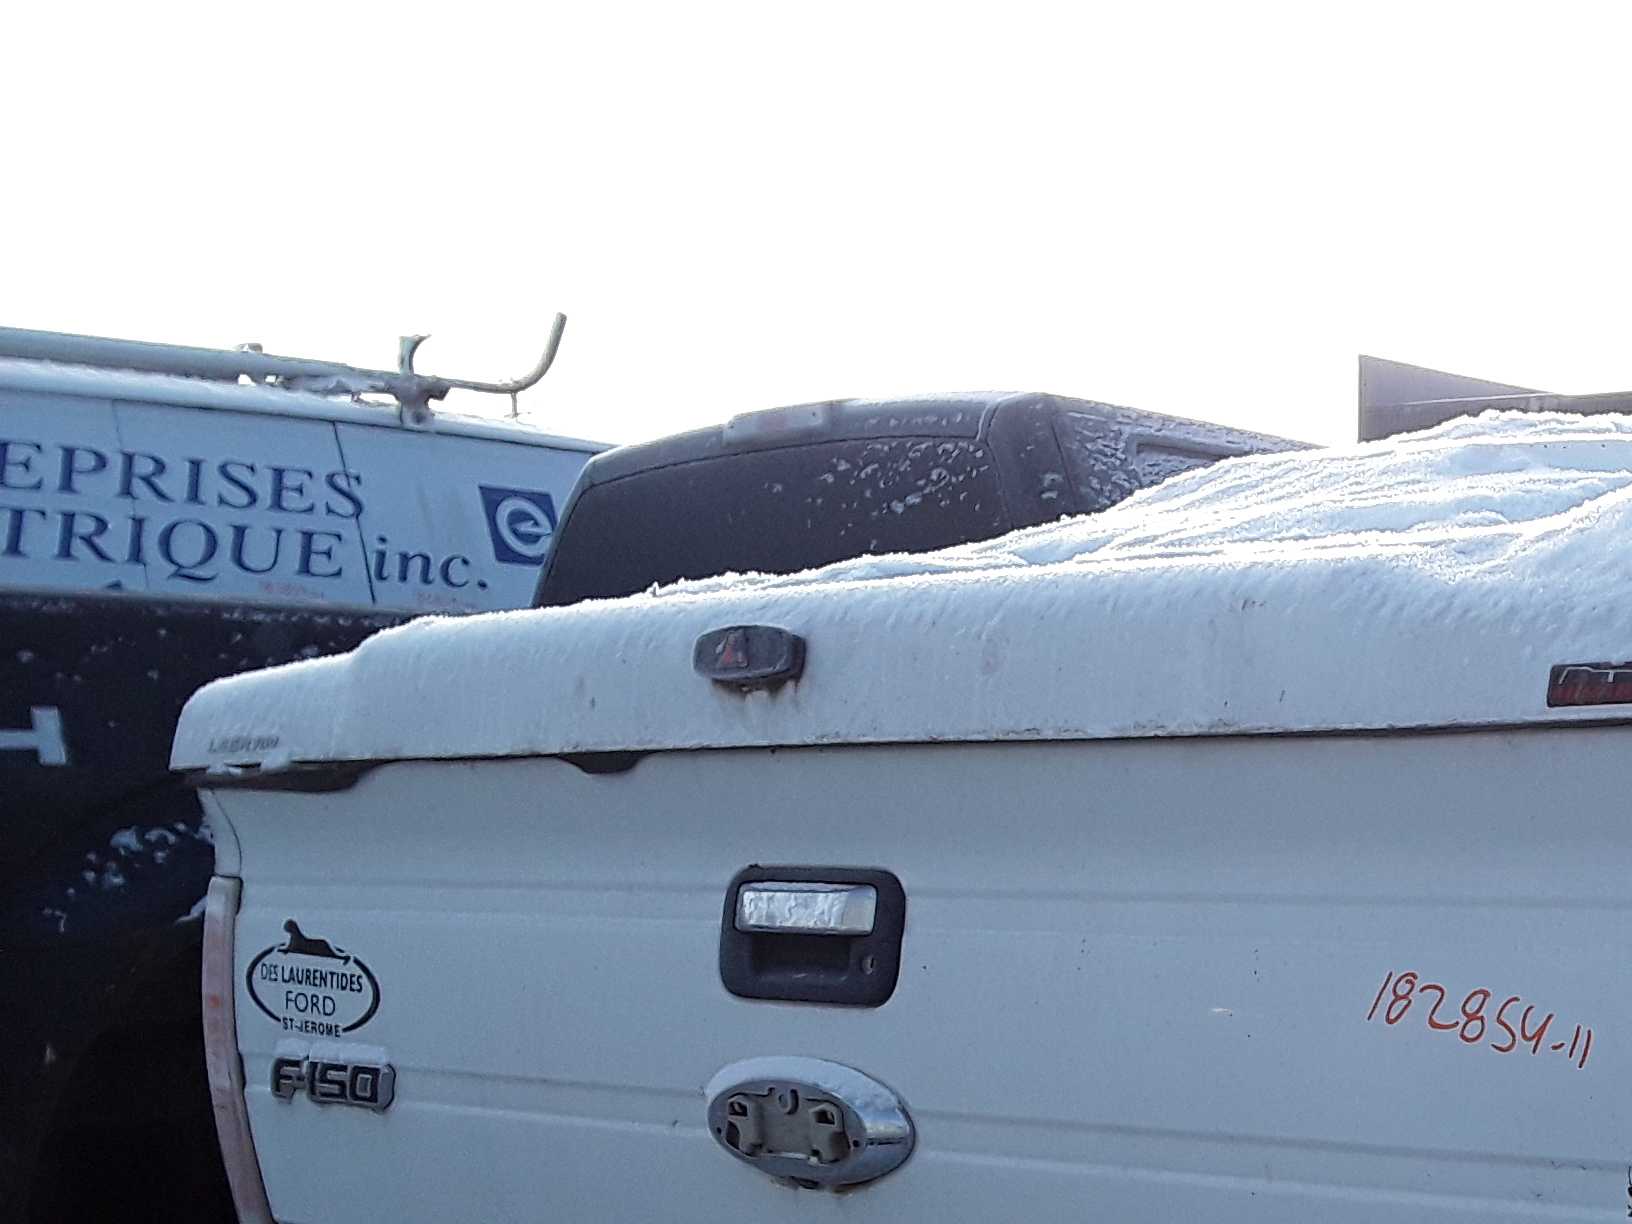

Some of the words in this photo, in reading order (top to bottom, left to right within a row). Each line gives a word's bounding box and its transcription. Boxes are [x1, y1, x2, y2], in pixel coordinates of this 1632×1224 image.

[0, 441, 364, 518] EPRISES
[0, 507, 344, 581] TRIQUE
[373, 535, 488, 590] inc.
[260, 963, 279, 982] DES
[281, 966, 363, 993] LAURENTIDES
[285, 990, 336, 1017] FORD
[282, 1016, 342, 1038] ST-JEROME
[1367, 971, 1592, 1069] 182854-11
